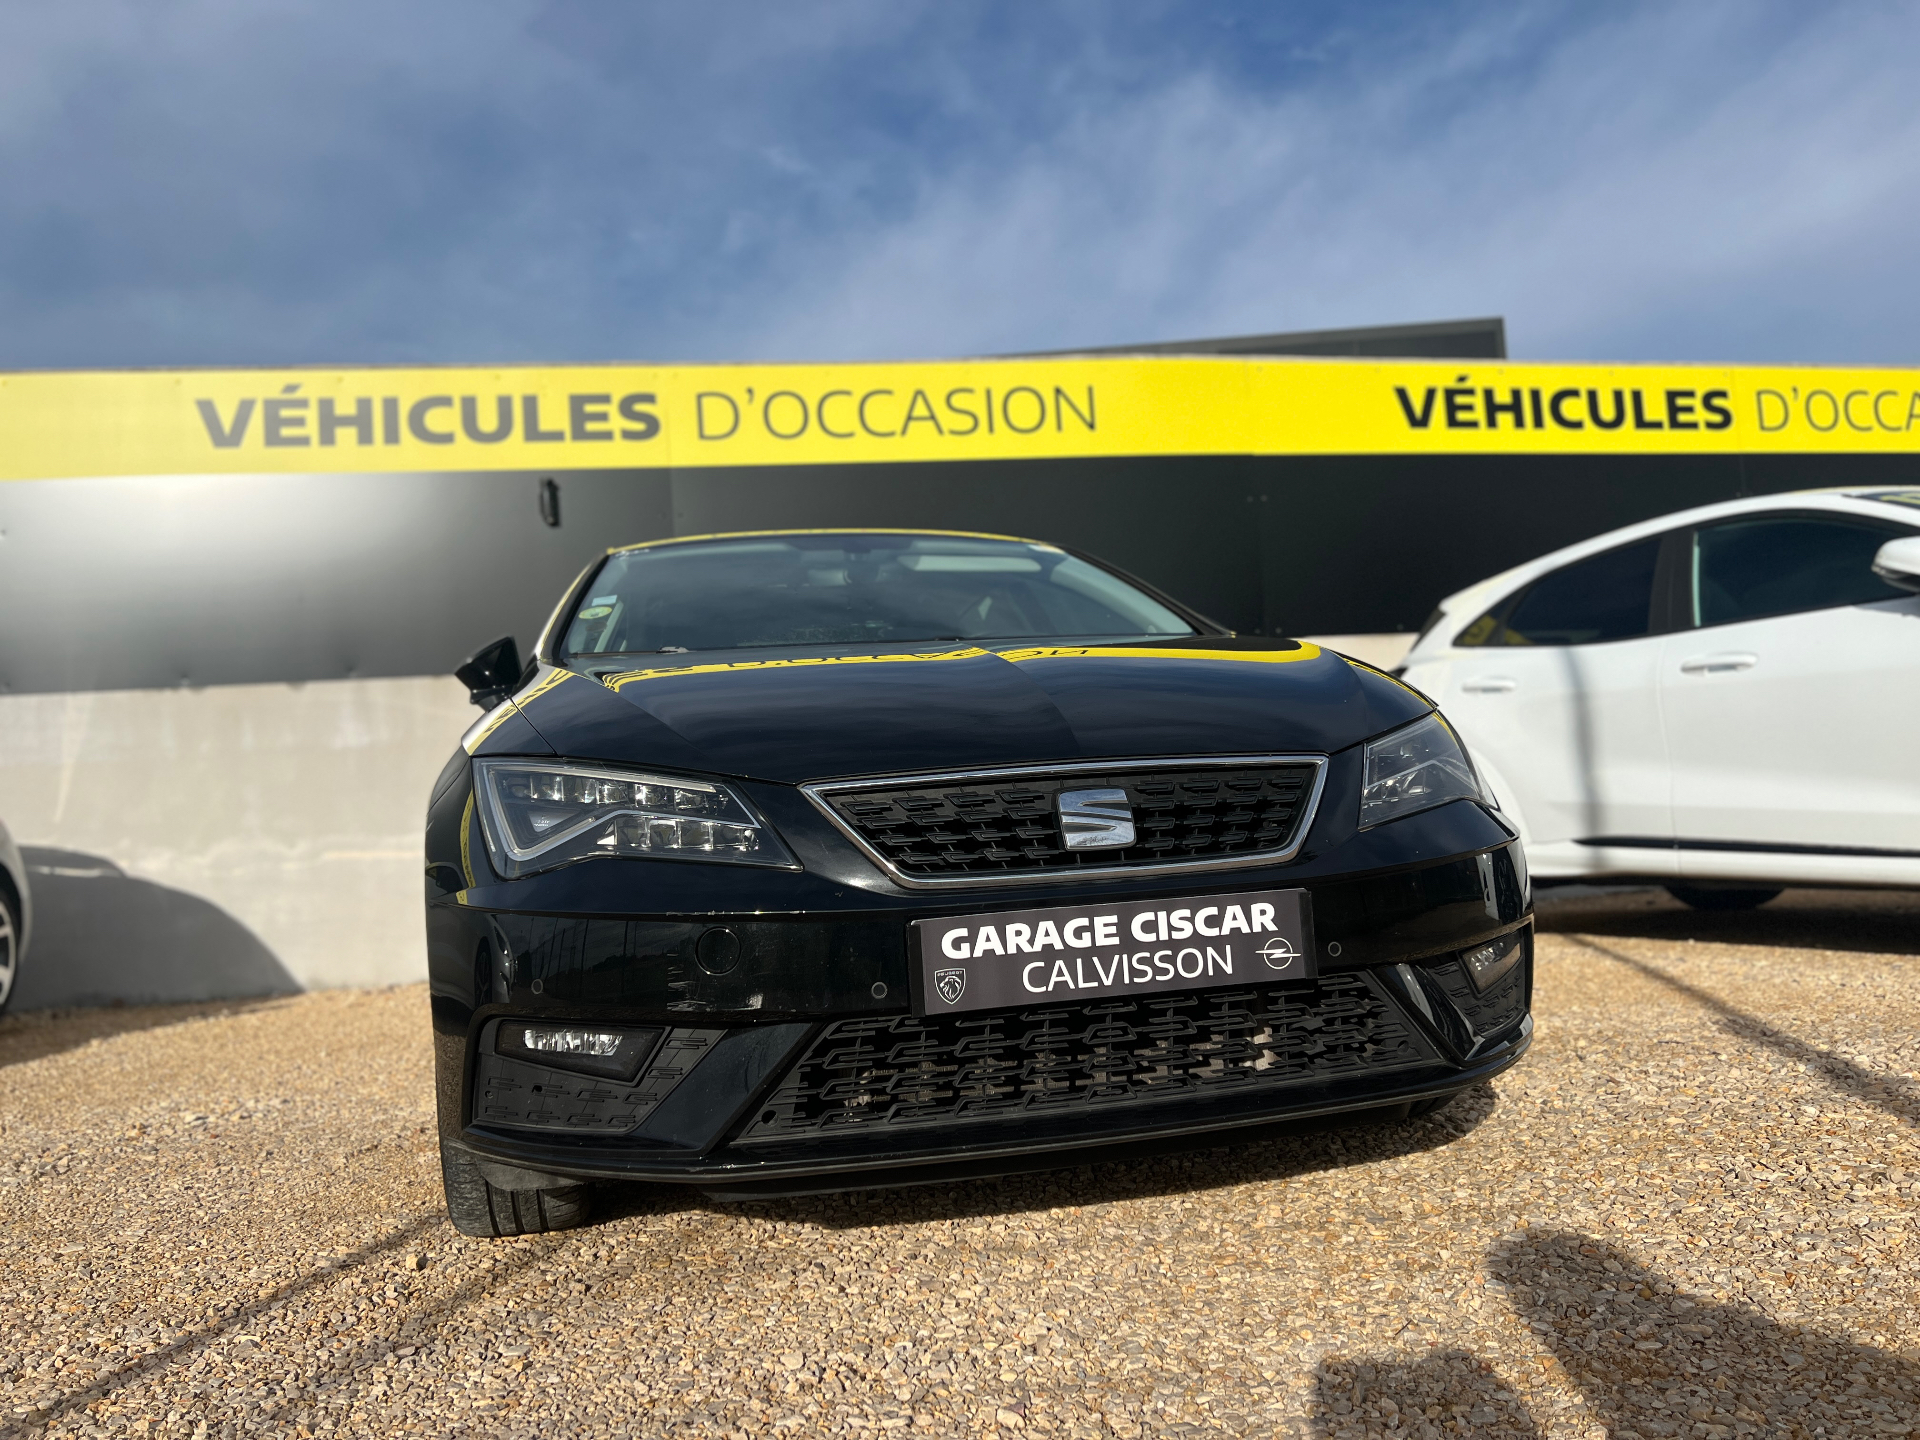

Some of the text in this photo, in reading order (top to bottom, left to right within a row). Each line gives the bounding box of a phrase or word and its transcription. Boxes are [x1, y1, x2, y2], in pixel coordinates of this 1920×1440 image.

[195, 384, 1097, 449] VÉHICULES D'OCCASION
[1394, 375, 1733, 431] VÉHICULES
[941, 902, 1278, 959] GARAGE CISCAR
[1022, 944, 1233, 993] CALVISSON
